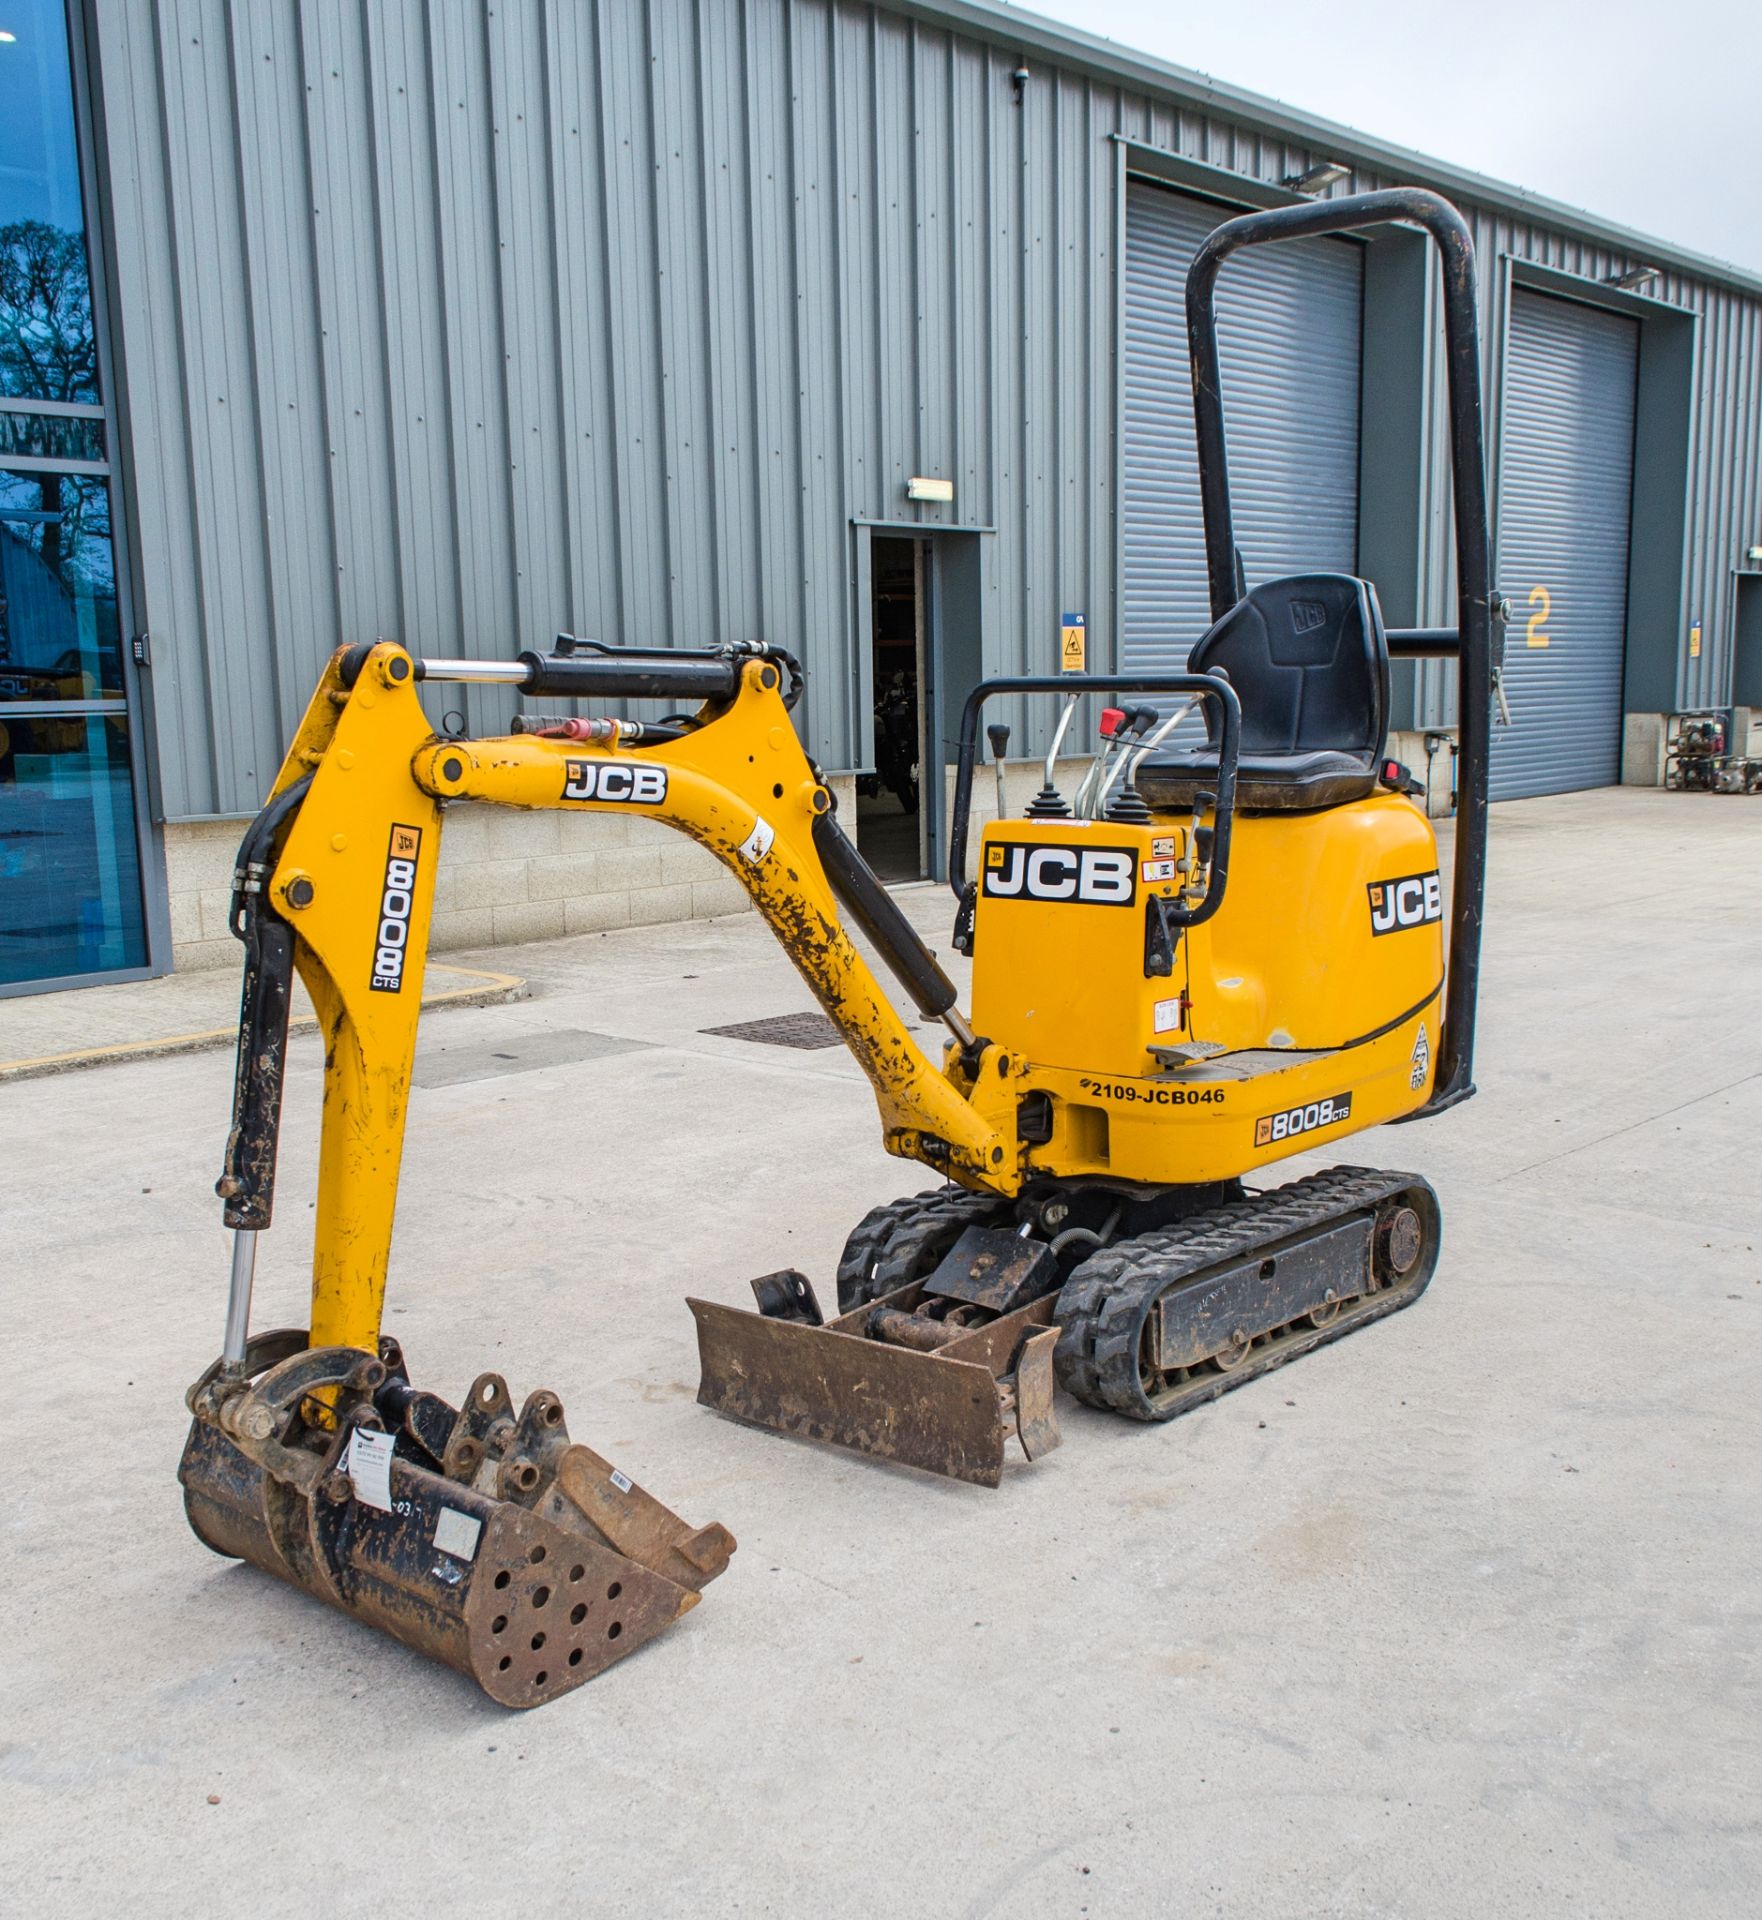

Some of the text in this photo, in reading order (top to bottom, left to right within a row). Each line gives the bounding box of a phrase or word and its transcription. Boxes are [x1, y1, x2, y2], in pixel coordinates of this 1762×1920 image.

[1527, 586, 1550, 648] 2
[565, 764, 666, 802] JCB
[986, 848, 1133, 902] JCB
[375, 859, 415, 977] 8008
[1372, 875, 1441, 931] JCB
[372, 976, 400, 989] CTS
[1091, 1082, 1225, 1105] 2109-JCB046
[1272, 1099, 1334, 1140] 8008
[1332, 1106, 1350, 1121] CTS
